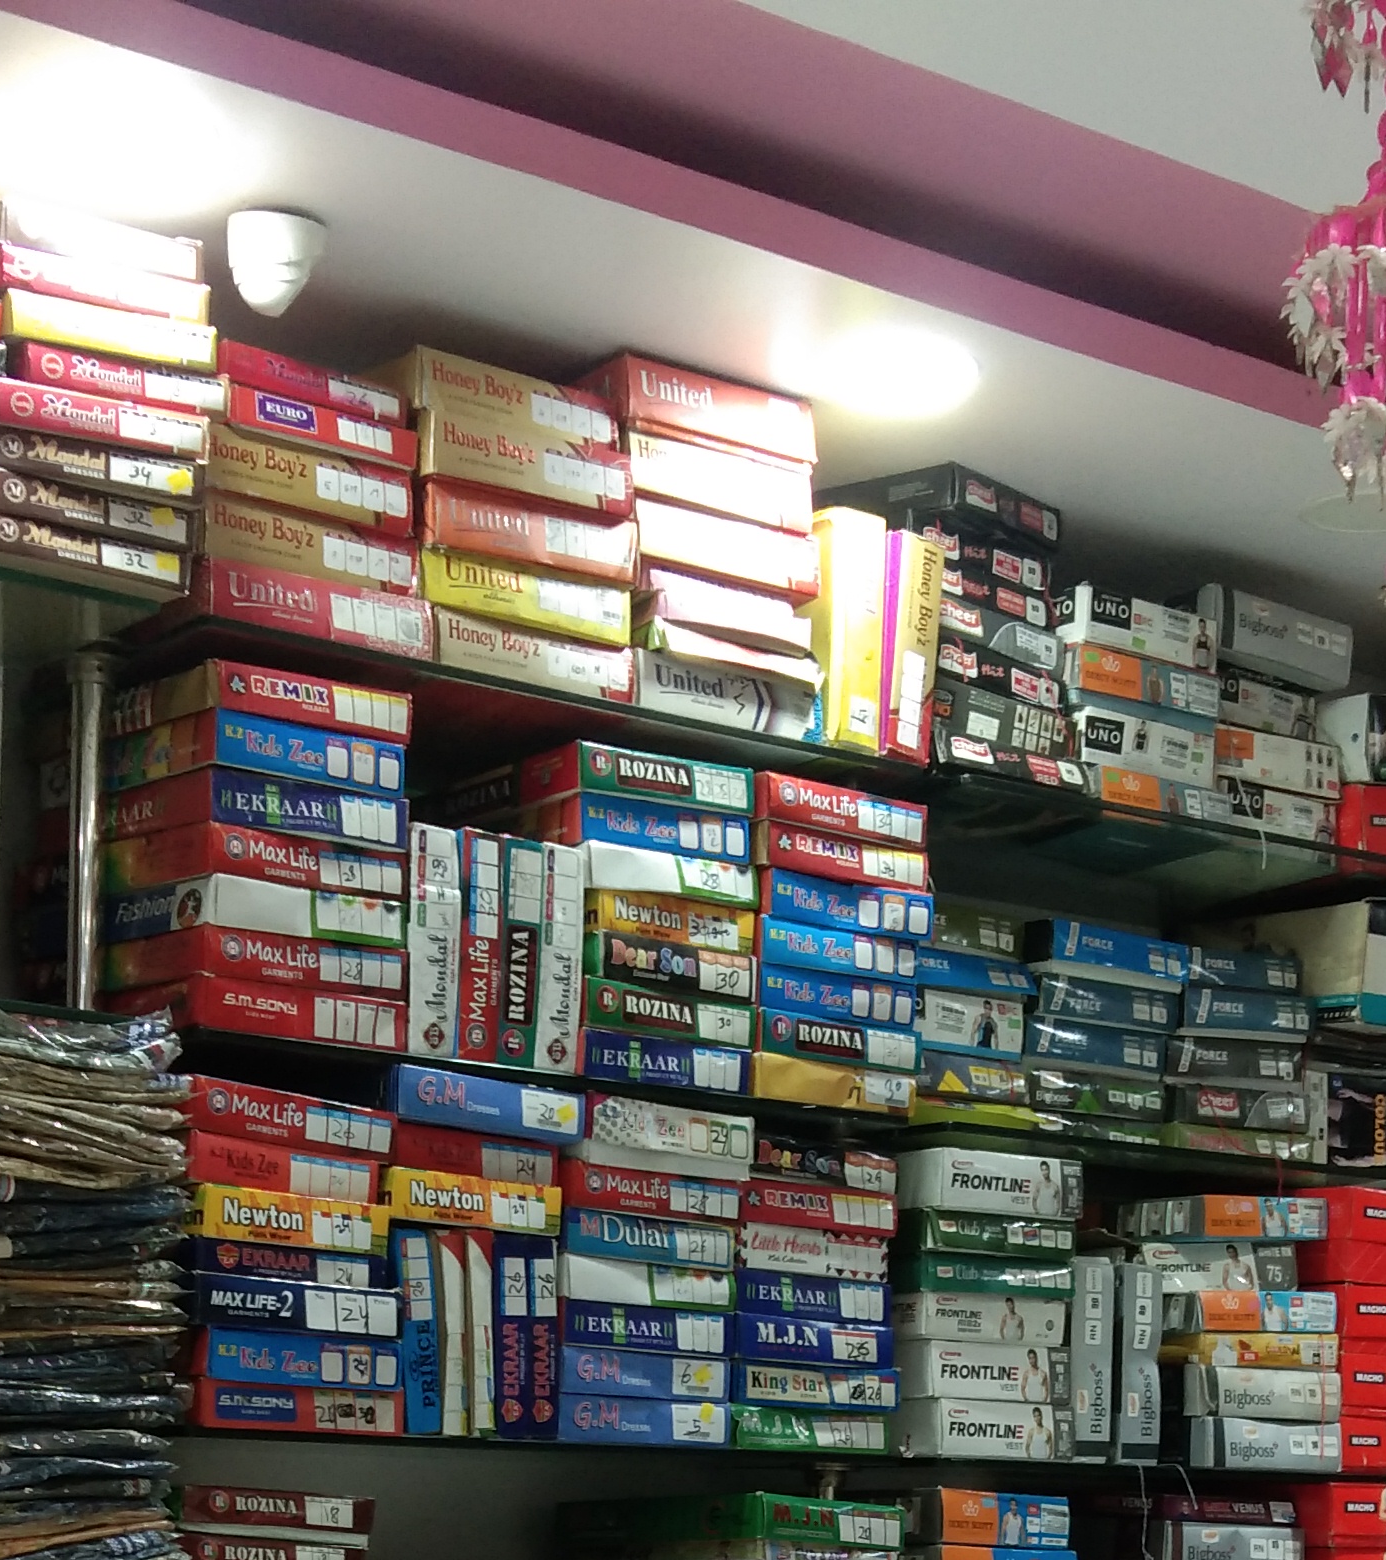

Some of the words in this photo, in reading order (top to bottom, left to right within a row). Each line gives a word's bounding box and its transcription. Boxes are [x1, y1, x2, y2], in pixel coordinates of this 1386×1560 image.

[70, 356, 141, 387] Mondal
[431, 361, 480, 399] Honey
[485, 374, 523, 405] Boy'z
[41, 394, 114, 426] Mondal
[265, 401, 308, 421] EURO
[214, 504, 267, 537] Honey
[271, 516, 313, 549] Boy'z
[449, 498, 530, 537] United
[24, 522, 98, 556] Mondal
[445, 556, 523, 593] United
[228, 571, 318, 613] United
[1093, 600, 1130, 619] UNO
[250, 676, 329, 705] REMIX
[655, 664, 725, 699] United
[1087, 728, 1121, 745] UNO
[619, 757, 689, 786] ROZINA
[236, 793, 325, 820] EKRAAR
[800, 788, 830, 811] Max
[833, 796, 857, 817] Life
[796, 834, 859, 862] REMIX
[116, 897, 175, 924] Fashion
[614, 896, 681, 929] Newton
[246, 940, 283, 963] Max
[287, 944, 319, 968] Life
[612, 939, 656, 969] Dear
[660, 949, 697, 977] Son
[1205, 958, 1235, 971] FORCE
[262, 969, 302, 979] GARMENTS
[508, 931, 529, 1022] ROZINA
[625, 994, 693, 1024] ROZINA
[1213, 1003, 1244, 1014] FORCE
[798, 1025, 862, 1050] ROZINA
[603, 1050, 679, 1072] EKRAAR
[1196, 1050, 1228, 1062] FORCE
[232, 1095, 270, 1119] Max
[273, 1102, 304, 1127] Life
[951, 1173, 1031, 1194] FRONTLINE
[410, 1181, 484, 1212] Newton
[765, 1190, 829, 1211] REMIX
[1011, 1196, 1030, 1204] VEST
[223, 1198, 303, 1231] Newton
[243, 1249, 310, 1270] EKRAAR
[211, 1290, 243, 1308] MAX
[245, 1291, 293, 1317] LIFE-2
[759, 1285, 827, 1305] EKRAAR
[935, 1308, 982, 1319] FRONTLINE
[1359, 1305, 1386, 1314] MACHO
[587, 1317, 662, 1337] EKRAAR
[757, 1321, 819, 1346] M.J.N
[532, 1323, 549, 1397] EKRAAR
[578, 1355, 620, 1382] G.M
[940, 1364, 1018, 1381] FRONTLINE
[751, 1370, 788, 1393] King
[792, 1372, 823, 1392] Star
[1000, 1383, 1018, 1391] VEST
[1356, 1373, 1383, 1383] MACHO
[1224, 1389, 1271, 1409] Bigboss
[949, 1422, 1024, 1439] FRONTLINE
[1352, 1437, 1378, 1446] MACHO
[1230, 1442, 1275, 1459] Bigboss
[235, 1495, 298, 1515] ROZINA
[773, 1504, 834, 1526] M.J.N
[1233, 1504, 1265, 1514] VENUS
